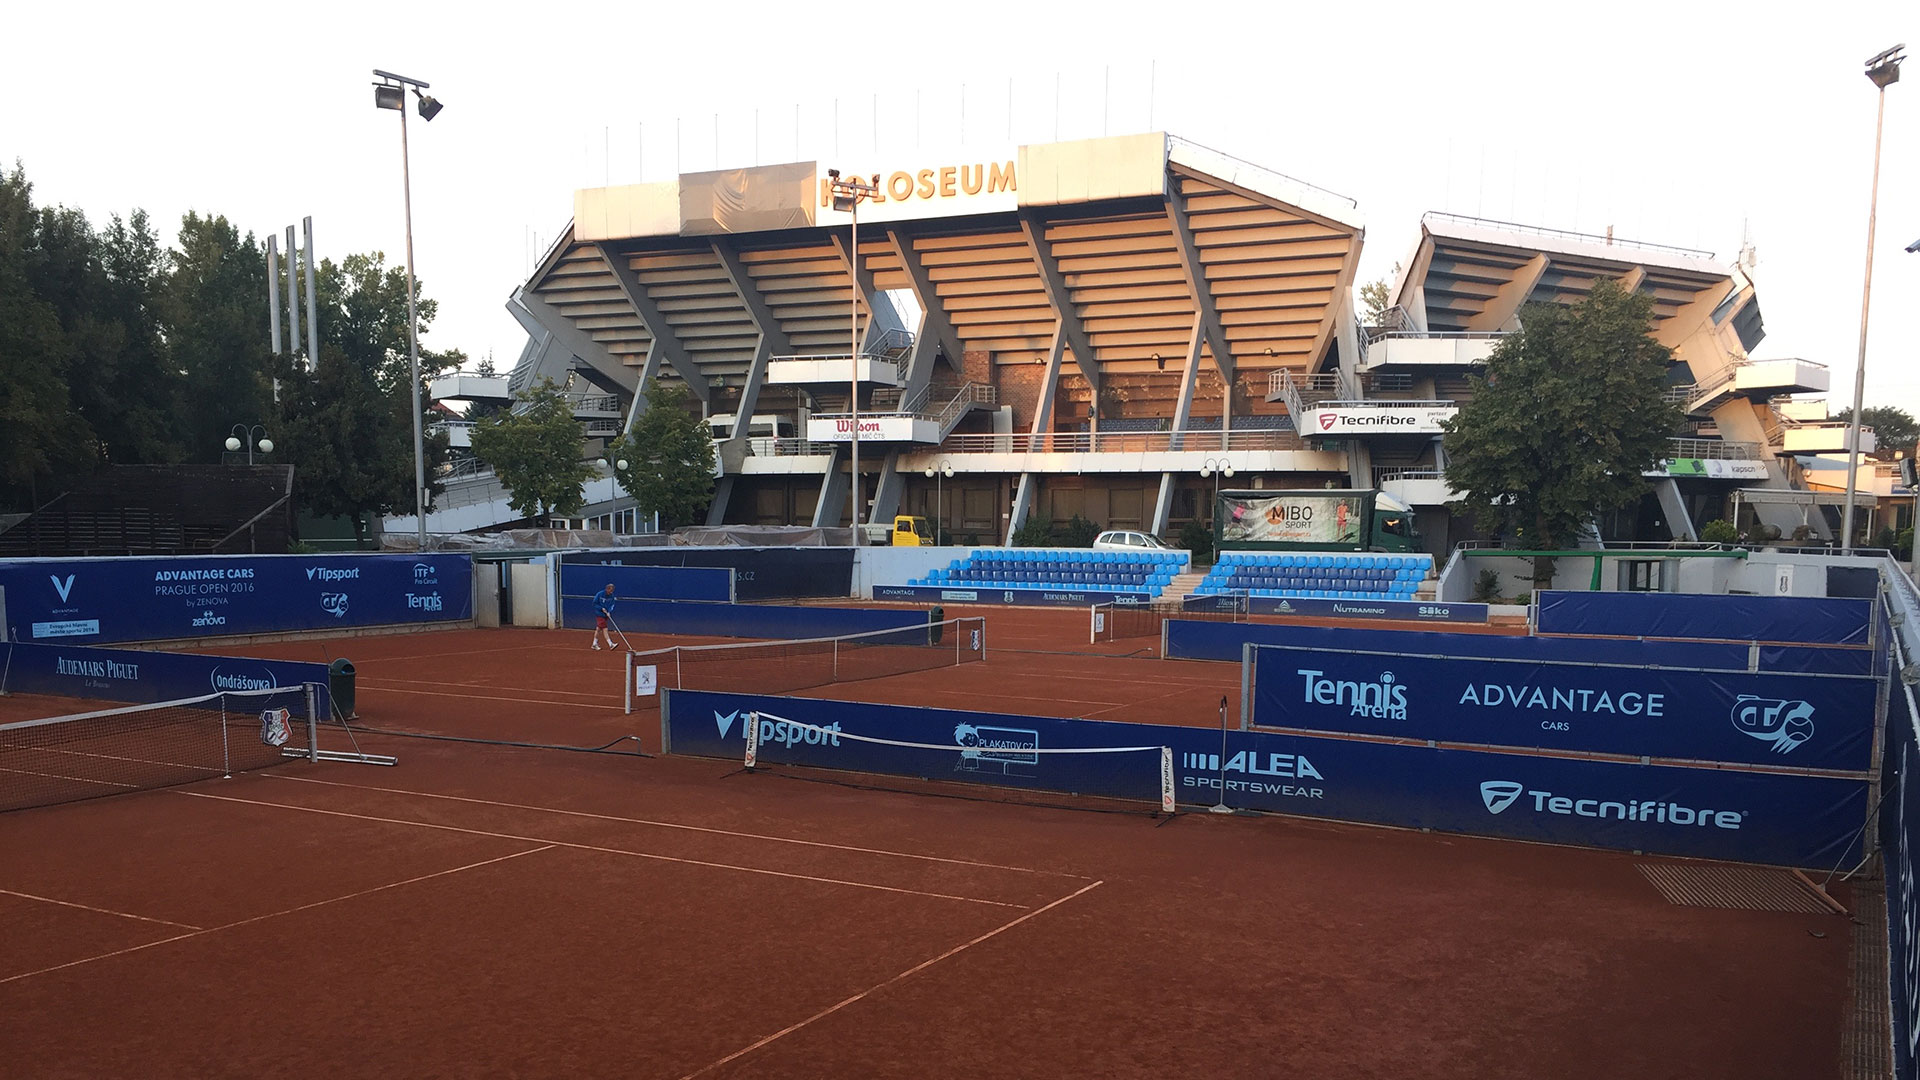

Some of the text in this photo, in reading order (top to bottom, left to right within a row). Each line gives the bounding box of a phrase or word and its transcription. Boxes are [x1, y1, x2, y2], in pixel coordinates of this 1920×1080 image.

[1340, 416, 1416, 425] Tecnifibre
[1272, 506, 1312, 521] MIBO
[1285, 521, 1312, 529] SPORT
[155, 568, 255, 581] ADVANTAGE CARS
[317, 567, 360, 581] Tipsport
[414, 568, 429, 578] ITF
[155, 582, 255, 596] PRAGUE OPEN 2016
[186, 597, 229, 608] by ZENOVA
[405, 590, 442, 608] Tennis
[1333, 603, 1385, 614] NUTRAMINO
[192, 616, 225, 627] zenova
[56, 656, 139, 680] AUDEMARS PIGUET
[1297, 669, 1407, 710] Tennis
[1459, 683, 1664, 717] ADVANTAGE
[1350, 703, 1407, 720] Arena
[740, 713, 842, 749] Tpsport
[1541, 721, 1570, 731] CARS
[1224, 751, 1324, 781] ALEA
[1183, 777, 1324, 799] SPORTSWEAR
[1528, 790, 1742, 829] Tecnifibre
